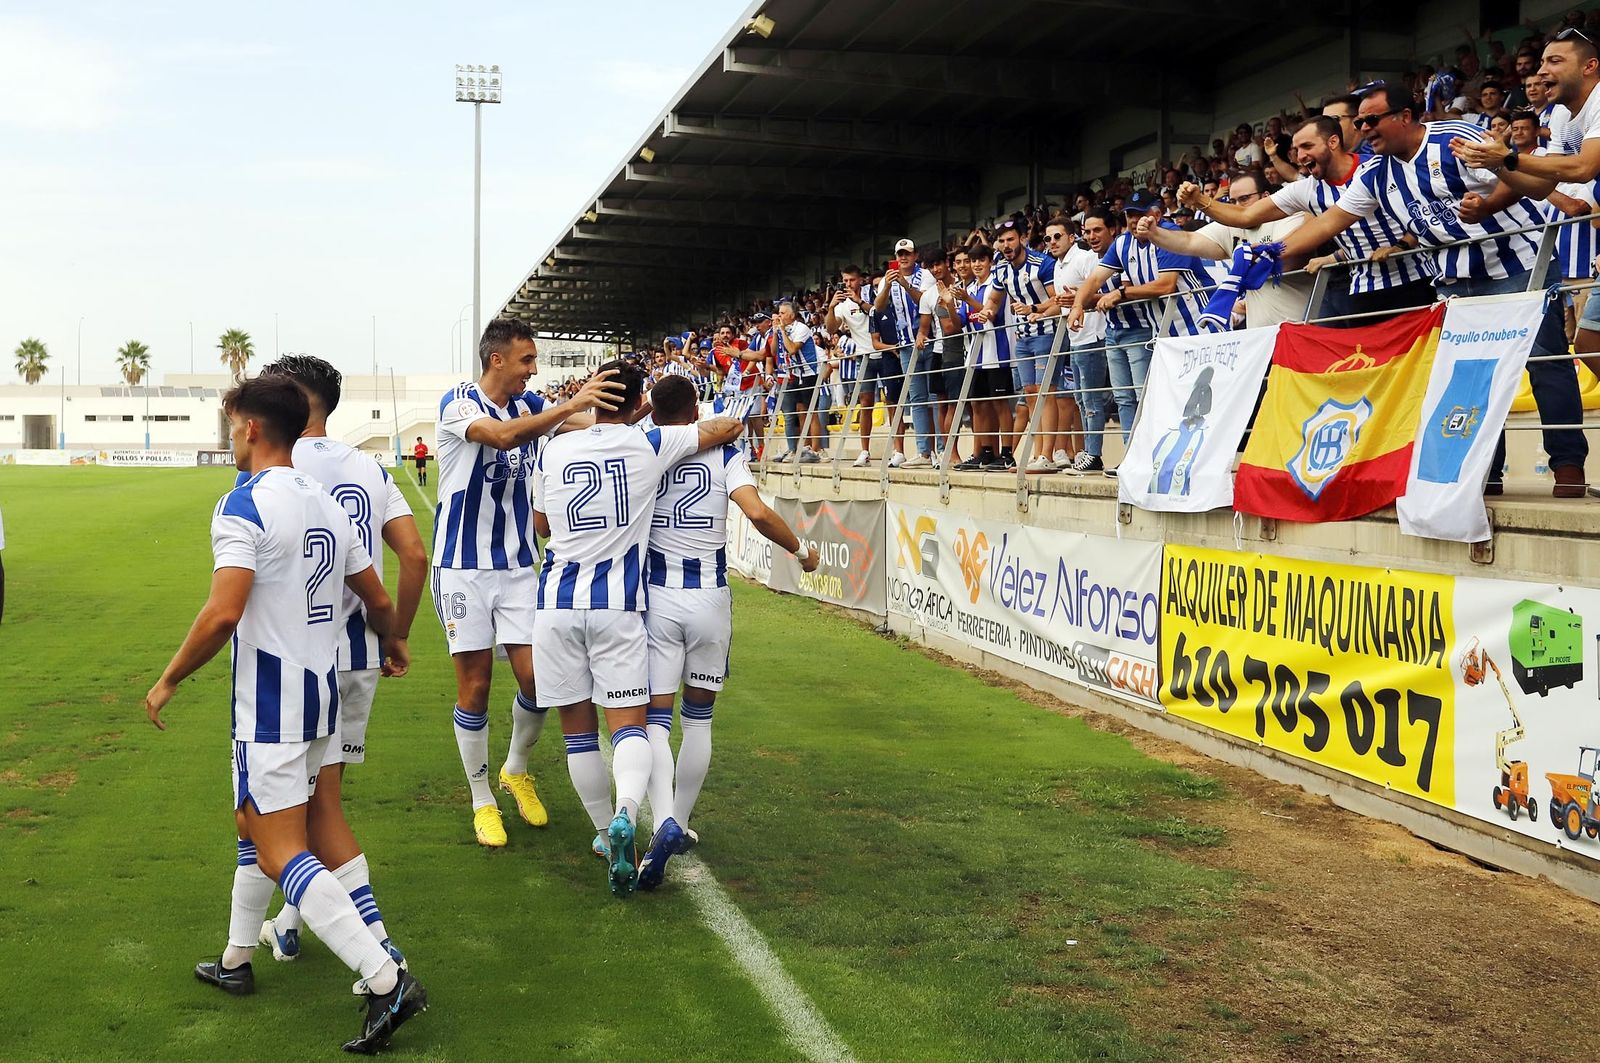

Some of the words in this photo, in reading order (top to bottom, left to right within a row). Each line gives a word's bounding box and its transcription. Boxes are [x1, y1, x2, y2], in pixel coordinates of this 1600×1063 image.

[1442, 331, 1480, 346] Orgullo
[563, 458, 629, 532] 21
[303, 527, 336, 625] 2
[819, 541, 850, 569] AUTO
[989, 532, 1048, 618] Vélez
[1049, 556, 1158, 645] Alfonso
[442, 591, 467, 620] 16
[1166, 557, 1247, 631] ALQUILER
[1252, 568, 1278, 637] DE
[1283, 573, 1446, 670] MAQUINARIA
[957, 610, 1012, 649] FERRETERIA
[1019, 630, 1076, 670] PINTURAS
[690, 672, 726, 684] ROME
[1169, 631, 1239, 714] 610
[1243, 653, 1332, 754] 705
[1340, 680, 1443, 793] 017
